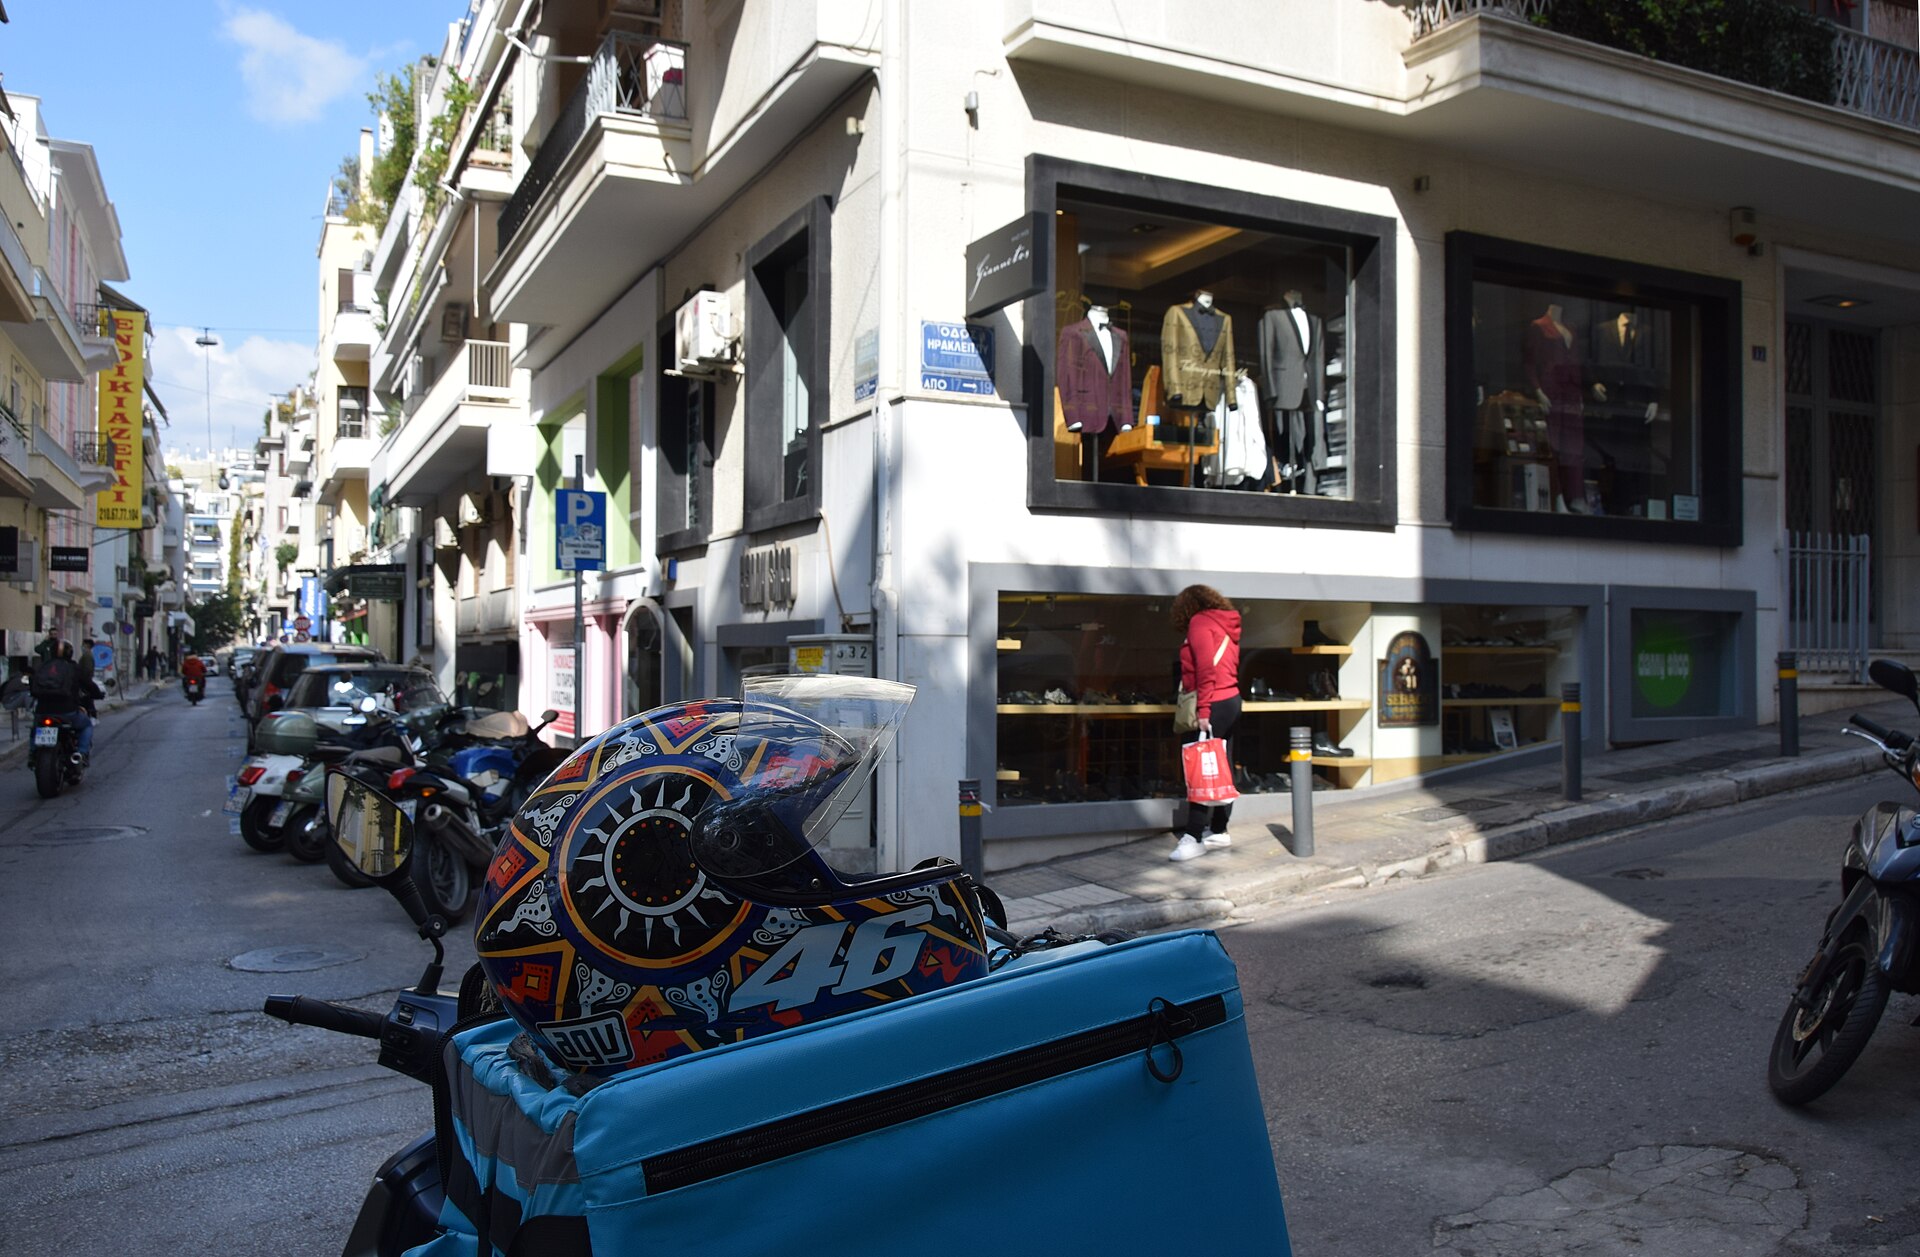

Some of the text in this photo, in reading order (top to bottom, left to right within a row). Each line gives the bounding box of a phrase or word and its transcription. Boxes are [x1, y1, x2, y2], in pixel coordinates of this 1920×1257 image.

[923, 378, 948, 391] ΑΠΟ
[567, 493, 595, 527] P
[1386, 693, 1431, 706] SEBA
[728, 904, 934, 1013] 46
[553, 1023, 619, 1065] agv
